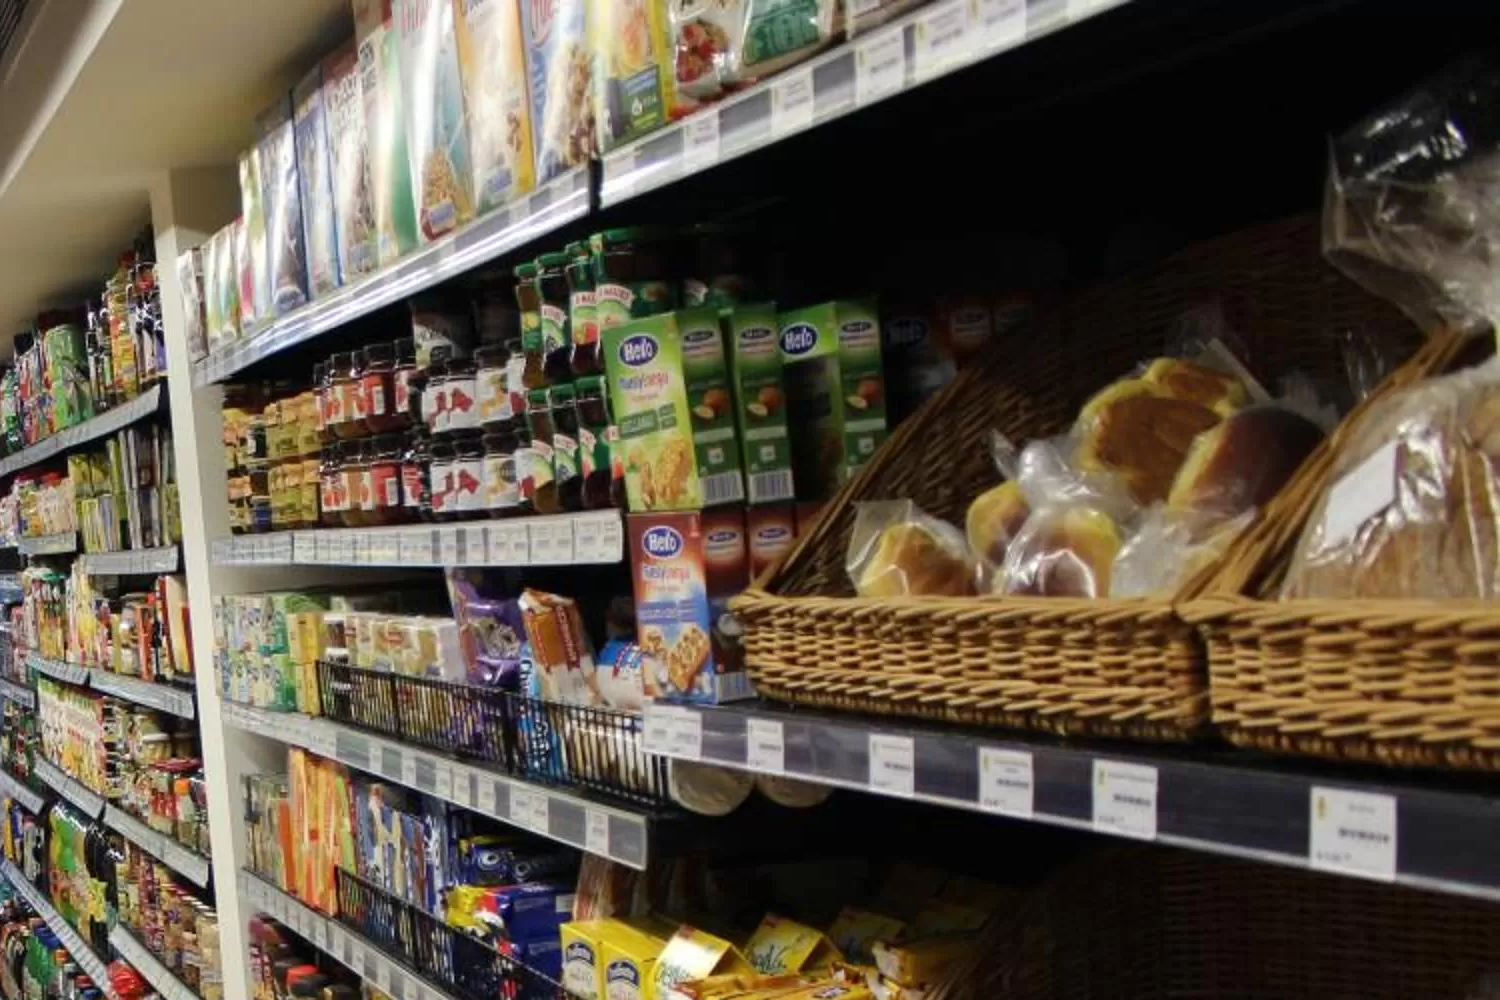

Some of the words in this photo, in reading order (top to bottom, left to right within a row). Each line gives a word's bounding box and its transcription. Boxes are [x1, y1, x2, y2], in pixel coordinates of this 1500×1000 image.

[624, 337, 653, 362] Hero
[785, 326, 813, 351] Hero
[647, 531, 677, 552] Hero
